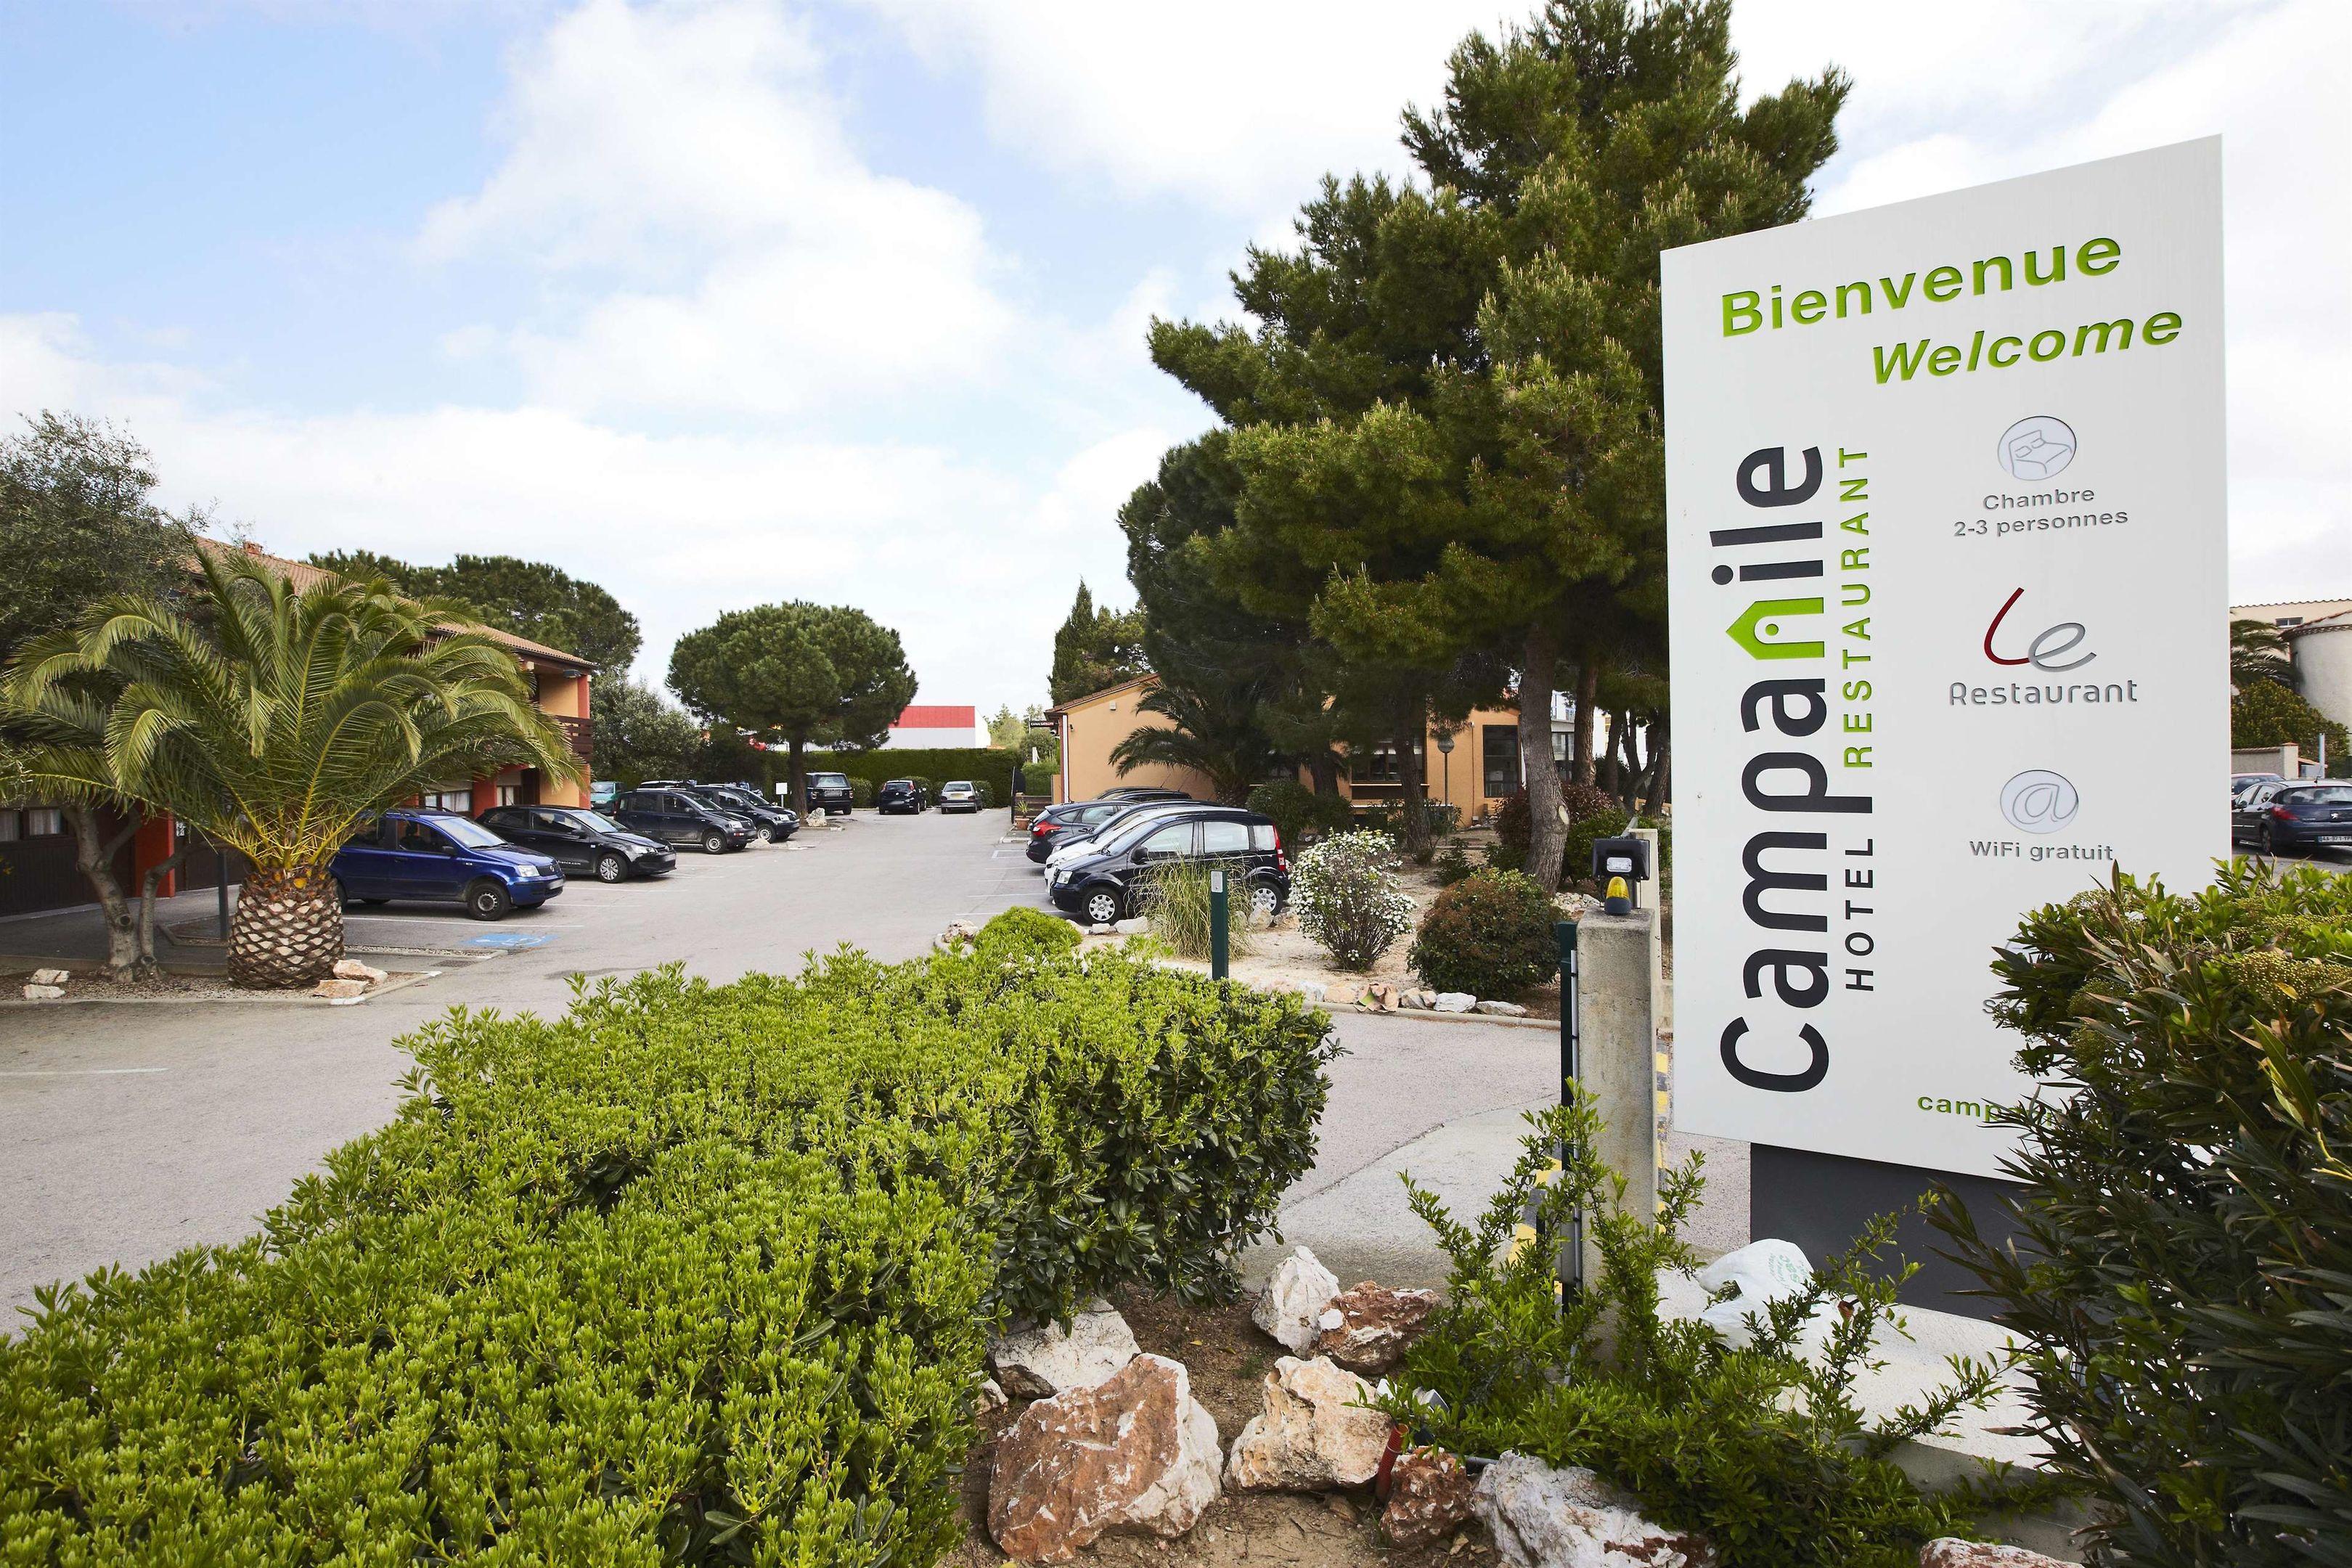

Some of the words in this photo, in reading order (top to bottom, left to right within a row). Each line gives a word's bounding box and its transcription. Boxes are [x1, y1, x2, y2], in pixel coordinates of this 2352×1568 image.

[1721, 236, 2121, 338] Bienvenue
[1872, 310, 2182, 385] Welcome
[1953, 519, 1988, 537] 2-3
[1996, 511, 2128, 537] personnes
[1983, 489, 2095, 510] Chambre
[1839, 448, 1873, 768] RESTAURANT
[1984, 587, 2097, 673] Le
[1949, 679, 2138, 706] Restaurant
[1710, 445, 1873, 1092] Campanile
[1969, 841, 2020, 857] WiFi
[2030, 844, 2114, 862] gratuit
[1845, 838, 1874, 992] HOTEL
